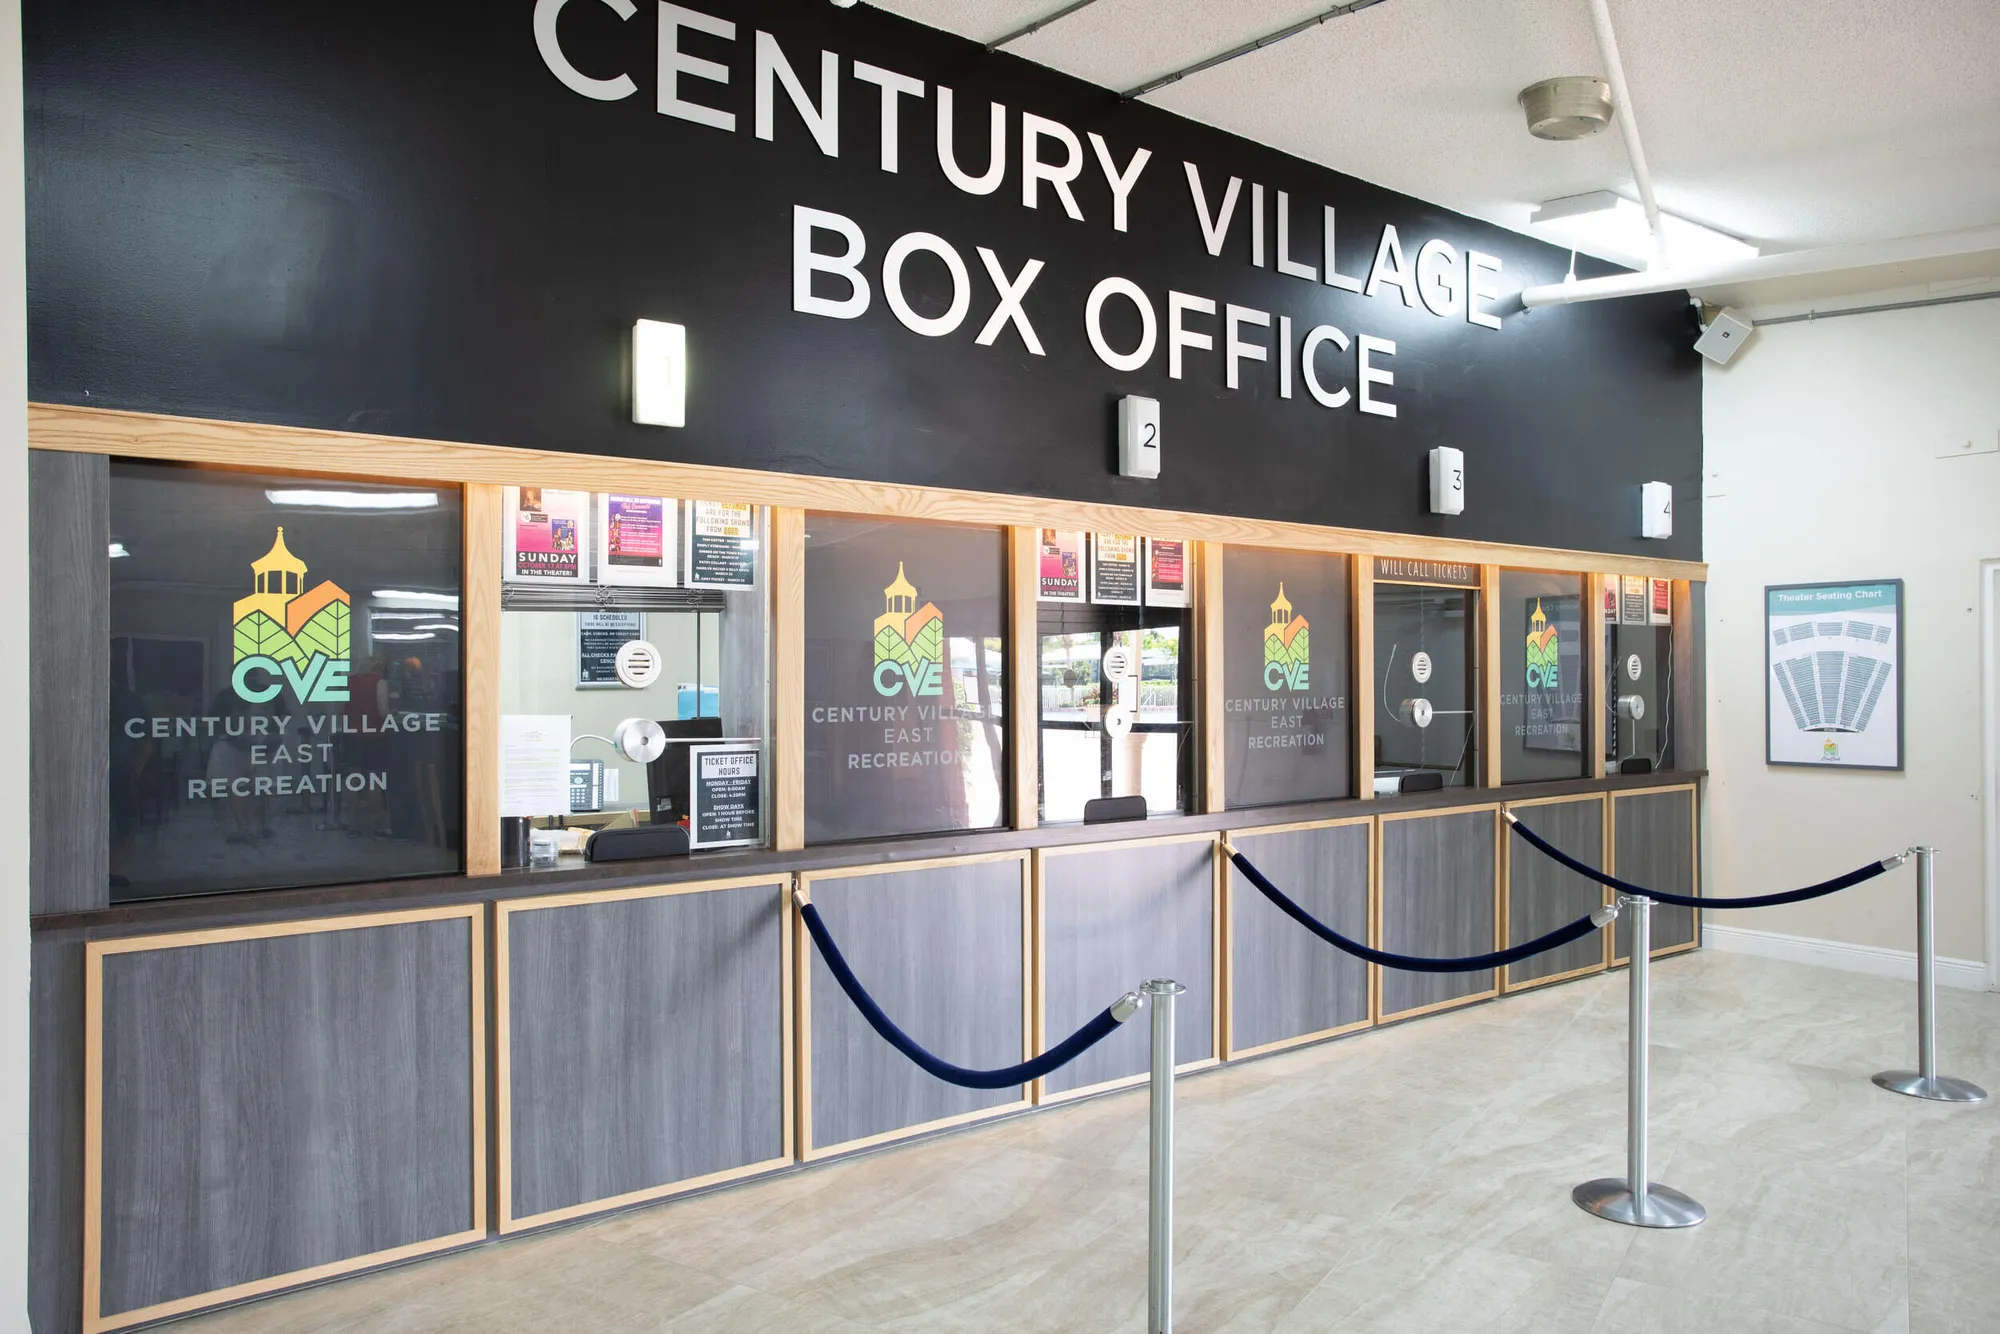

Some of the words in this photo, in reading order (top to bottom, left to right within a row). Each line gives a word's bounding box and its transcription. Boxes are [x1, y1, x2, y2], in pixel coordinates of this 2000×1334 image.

[532, 0, 1152, 232] CENTURY
[1183, 161, 1502, 330] VILLAGE
[793, 204, 1046, 356] BOX
[1085, 277, 1397, 418] OFFICE
[1143, 422, 1157, 449] 2
[1453, 469, 1463, 491] 3
[718, 509, 729, 517] FOR
[1663, 500, 1671, 518] 4
[696, 516, 729, 525] FOLLOWING
[706, 525, 722, 533] FROM
[519, 552, 577, 564] SUNDAY
[1380, 558, 1403, 575] WILL
[1407, 561, 1429, 577] CALL
[1433, 563, 1468, 580] TICKETS
[1041, 578, 1077, 587] SUNDAY
[1778, 593, 1813, 602] Theater
[1816, 591, 1852, 600] Seating
[1854, 589, 1882, 598] Chart
[231, 649, 350, 705] CVE
[873, 655, 943, 698] CVE
[1264, 658, 1310, 692] CVE
[1526, 660, 1558, 689] CVE
[1225, 698, 1287, 712] CENTURY
[1293, 697, 1345, 710] VILLAGE
[1500, 694, 1543, 705] CENTURY
[812, 706, 909, 724] CENTURY
[1531, 708, 1554, 719] EAST
[124, 716, 292, 739] CENTURY
[307, 713, 441, 734] VILLAGE
[1271, 716, 1303, 729] EAST
[1515, 723, 1568, 736] RECREATION
[884, 727, 934, 744] EAST
[1249, 733, 1324, 749] RECREATION
[251, 743, 334, 765] EAST
[705, 757, 728, 766] TICKET
[730, 756, 754, 765] OFFICE
[718, 767, 740, 776] HOURS
[188, 772, 387, 799] RECREATION
